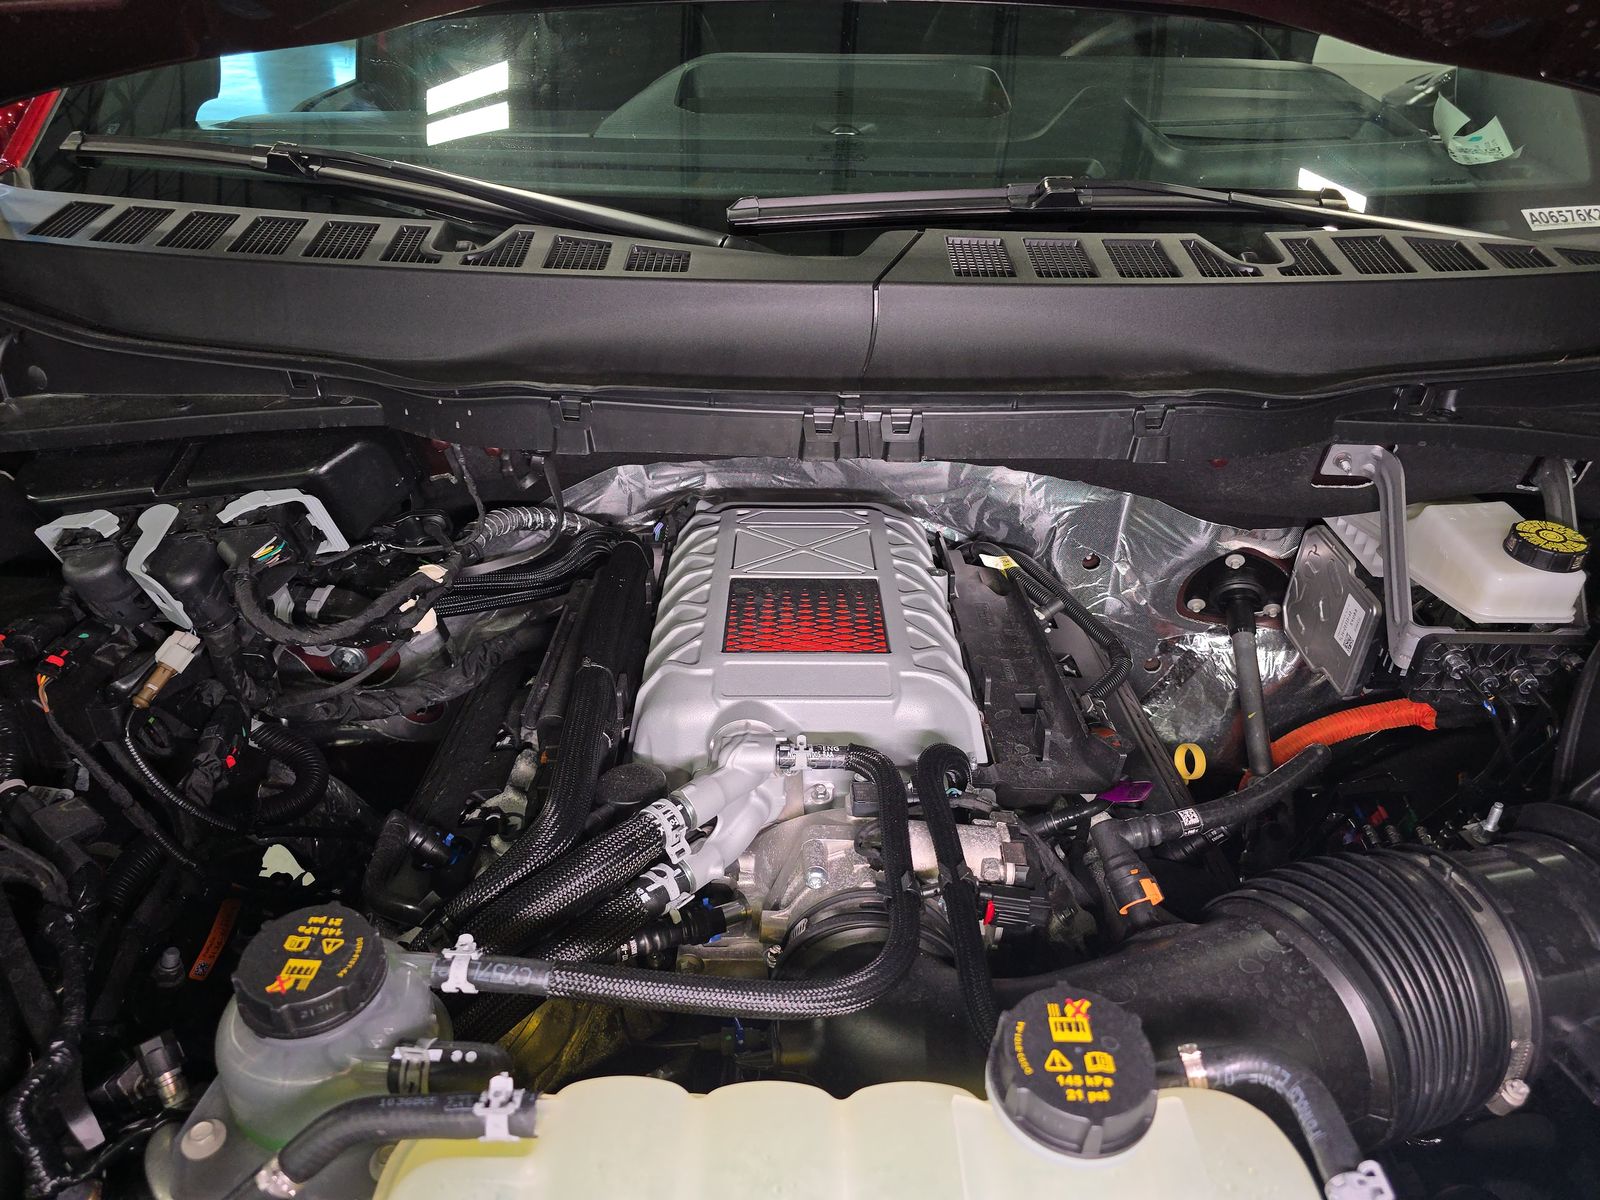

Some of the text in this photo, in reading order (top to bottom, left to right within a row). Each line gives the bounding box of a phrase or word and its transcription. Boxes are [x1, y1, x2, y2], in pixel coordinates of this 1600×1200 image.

[1056, 1074, 1114, 1088] 145 kPa
[1065, 1089, 1111, 1103] 21 psi
